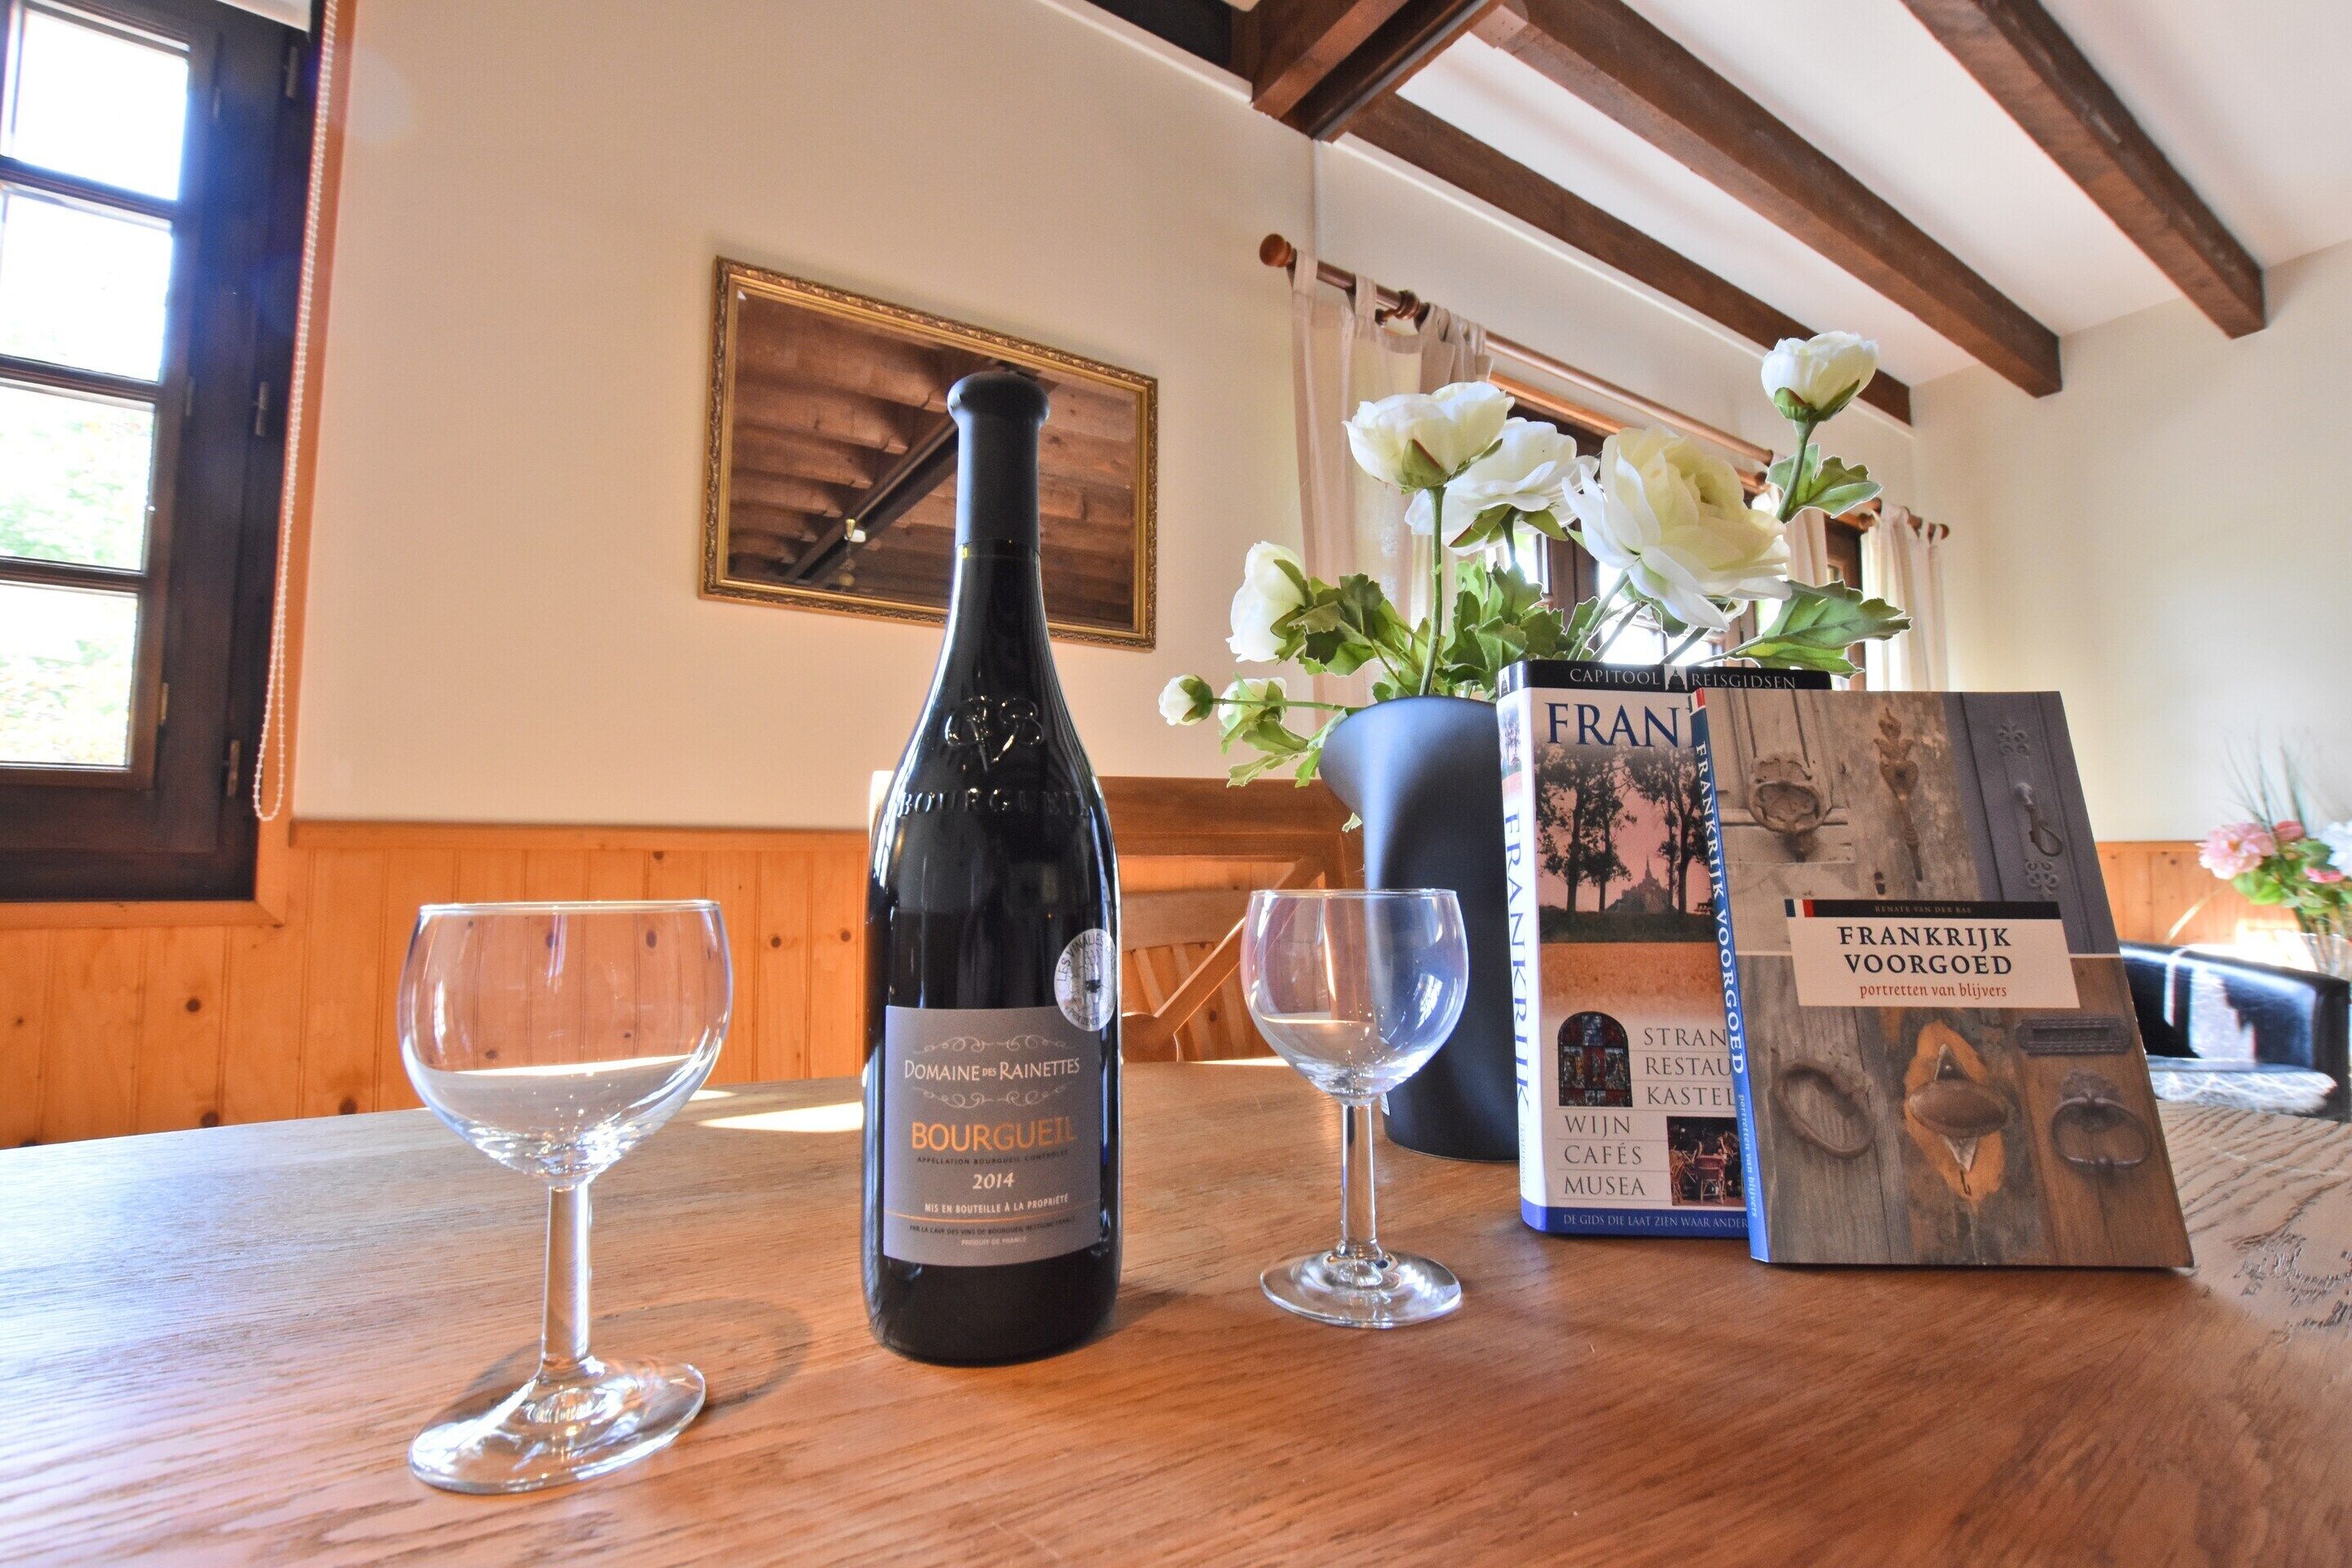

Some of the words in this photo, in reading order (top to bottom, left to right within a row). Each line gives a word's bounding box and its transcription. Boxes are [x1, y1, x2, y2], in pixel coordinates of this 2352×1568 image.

[1570, 668, 1660, 685] CAPITOOL
[1691, 673, 1796, 689] REISGIDSEN
[1545, 702, 1693, 748] FRAN
[1695, 741, 1725, 901] FRANKRIJK
[1716, 908, 1744, 1075] VOORGOED
[1875, 904, 1909, 913] RENATE
[1837, 926, 2011, 952] FRANKRIJK
[1057, 957, 1071, 982] LES
[1504, 812, 1530, 1113] FRANKRIJK
[1844, 954, 2012, 975] VOORGOED
[1860, 982, 1927, 999] portretten
[1931, 985, 1956, 997] van
[1959, 982, 2007, 1000] blijvers
[1643, 1027, 1727, 1047] STRAN
[904, 1059, 980, 1081] DOMAINE
[982, 1067, 997, 1077] DES
[1000, 1058, 1080, 1080] RAINETTES
[1646, 1056, 1732, 1077] RESTAU
[1646, 1085, 1736, 1107] KASTEL
[911, 1116, 1076, 1152] BOURGUEIL
[1564, 1115, 1630, 1138] WIJN
[917, 1156, 969, 1165] APPELLATION
[1564, 1143, 1642, 1165] CAFÉS
[1737, 1094, 1751, 1150] portretten
[1748, 1176, 1757, 1218] blijvers
[973, 1171, 1014, 1190] 2014
[1564, 1176, 1646, 1196] MUSEA
[924, 1203, 938, 1214] MIS
[942, 1204, 952, 1214] EN
[956, 1203, 1001, 1214] BOUTEILLE
[1004, 1201, 1010, 1213] À
[1013, 1202, 1024, 1211] LA
[1027, 1193, 1069, 1209] PROPRIÉTÉ
[1563, 1214, 1576, 1224] DE
[1579, 1214, 1605, 1225] GIDS
[1608, 1215, 1624, 1225] DIE
[1628, 1216, 1651, 1226] LAAT
[1655, 1216, 1677, 1227] ZIEN
[1681, 1217, 1710, 1227] WAAR
[1713, 1218, 1749, 1228] ANDER
